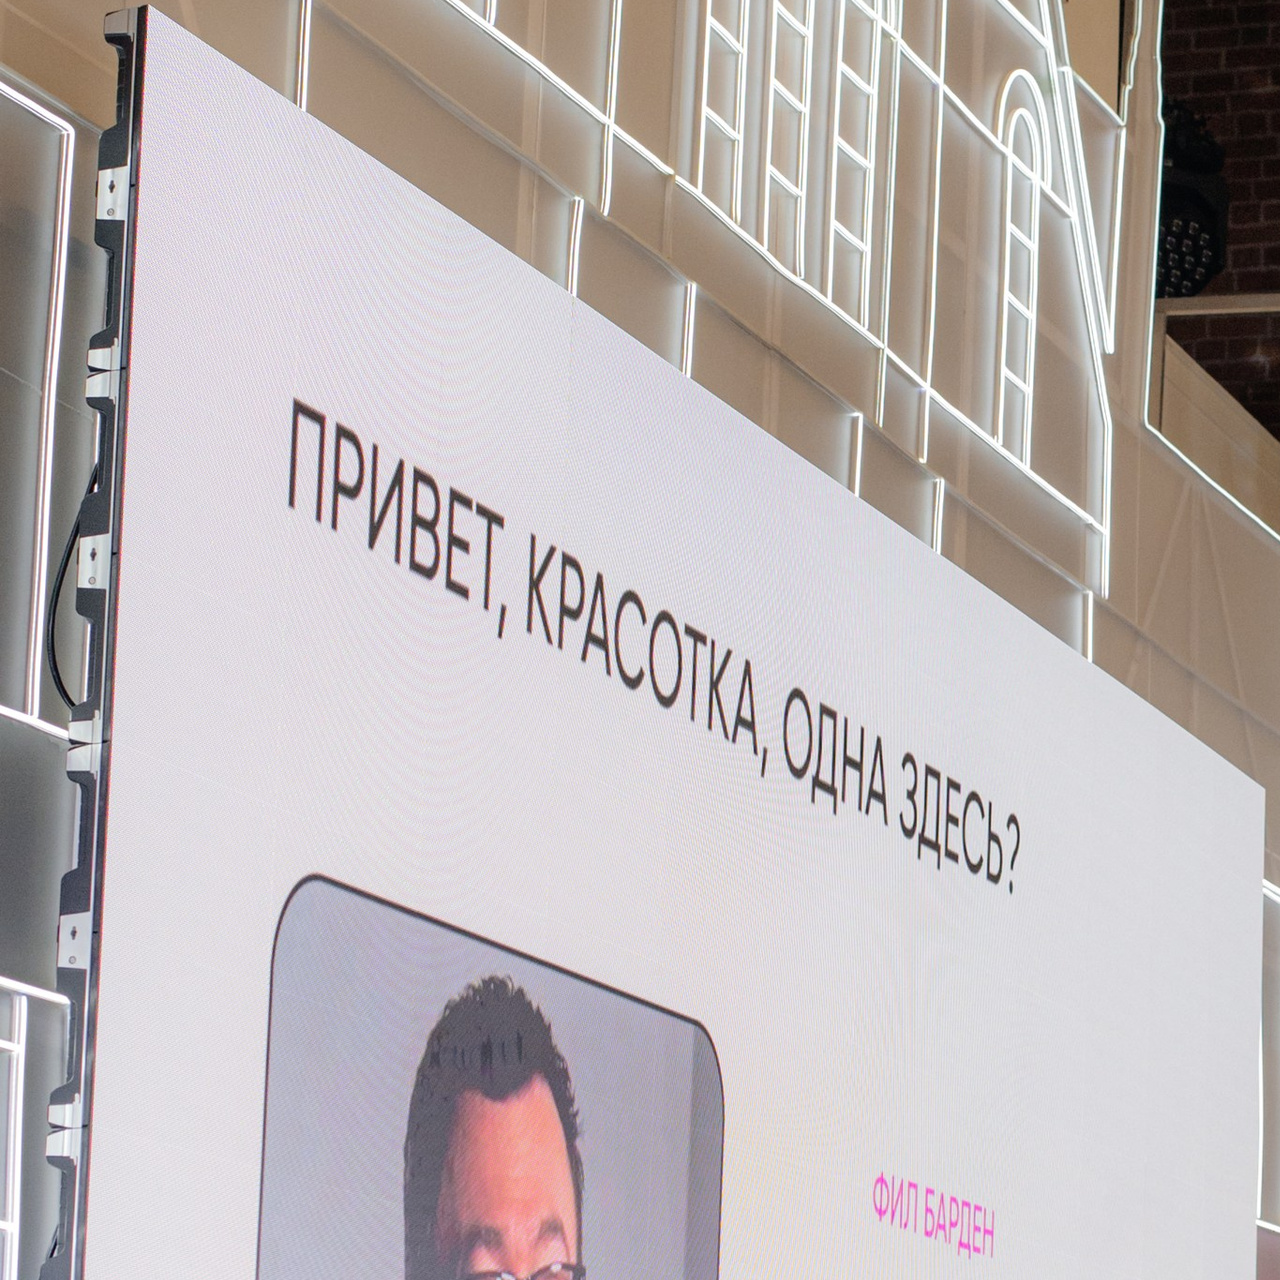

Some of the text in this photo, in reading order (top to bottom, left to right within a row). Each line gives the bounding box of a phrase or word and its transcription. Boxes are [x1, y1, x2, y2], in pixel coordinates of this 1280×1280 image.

[286, 397, 1022, 895] ПРИВЕТ, КРАСОТКА, ОДНА ЗДЕСЬ?
[872, 1171, 996, 1260] ФИЛ БАРДЕН
